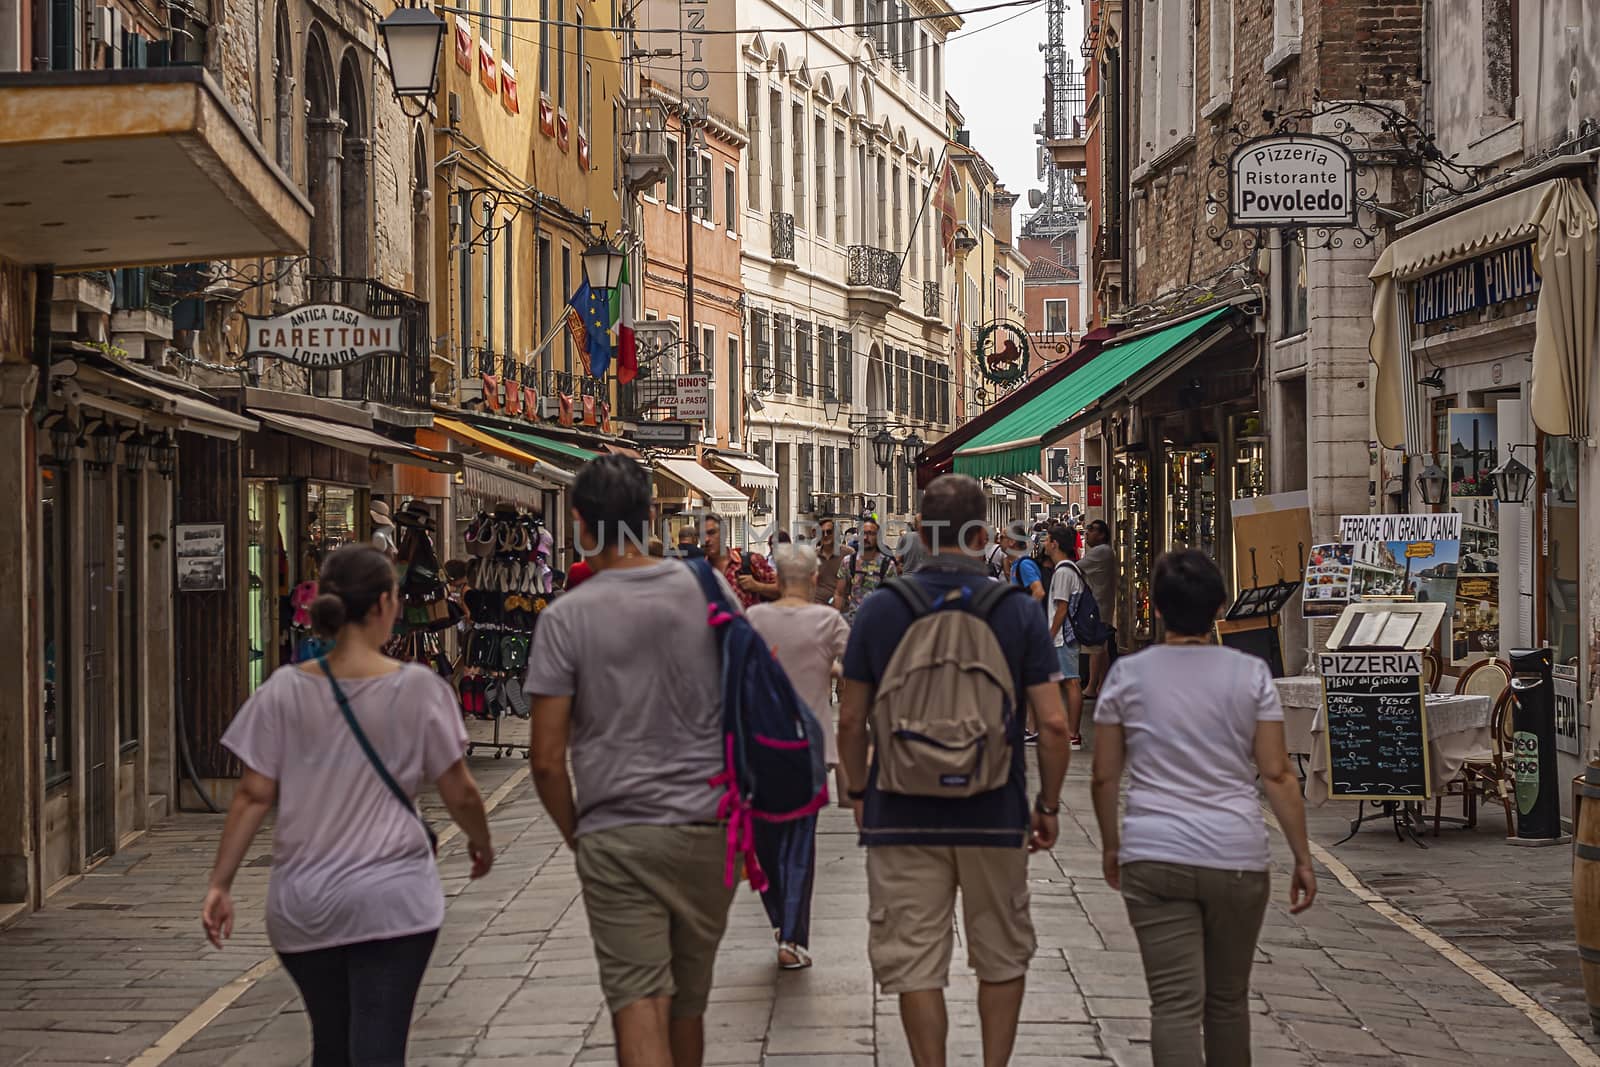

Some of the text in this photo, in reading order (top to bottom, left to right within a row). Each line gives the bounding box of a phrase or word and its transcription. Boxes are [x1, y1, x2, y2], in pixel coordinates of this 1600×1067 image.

[685, 0, 710, 208] ZIONALE
[1254, 148, 1328, 166] Pizzeria
[1246, 171, 1337, 185] Ristorante
[1242, 189, 1344, 212] Povoledo
[1413, 263, 1475, 324] TRATTORIA
[290, 308, 359, 327] ANTICA CASA
[258, 327, 391, 348] CARETTONI
[292, 347, 359, 366] LOCANDA
[677, 377, 707, 388] GINO'S
[659, 397, 679, 405] PIZZA
[685, 396, 707, 405] PASTA
[1343, 516, 1458, 542] TERRACE ON GRAND CANAL
[1321, 655, 1420, 674] PIZZERIA
[1327, 696, 1354, 704] CARNE
